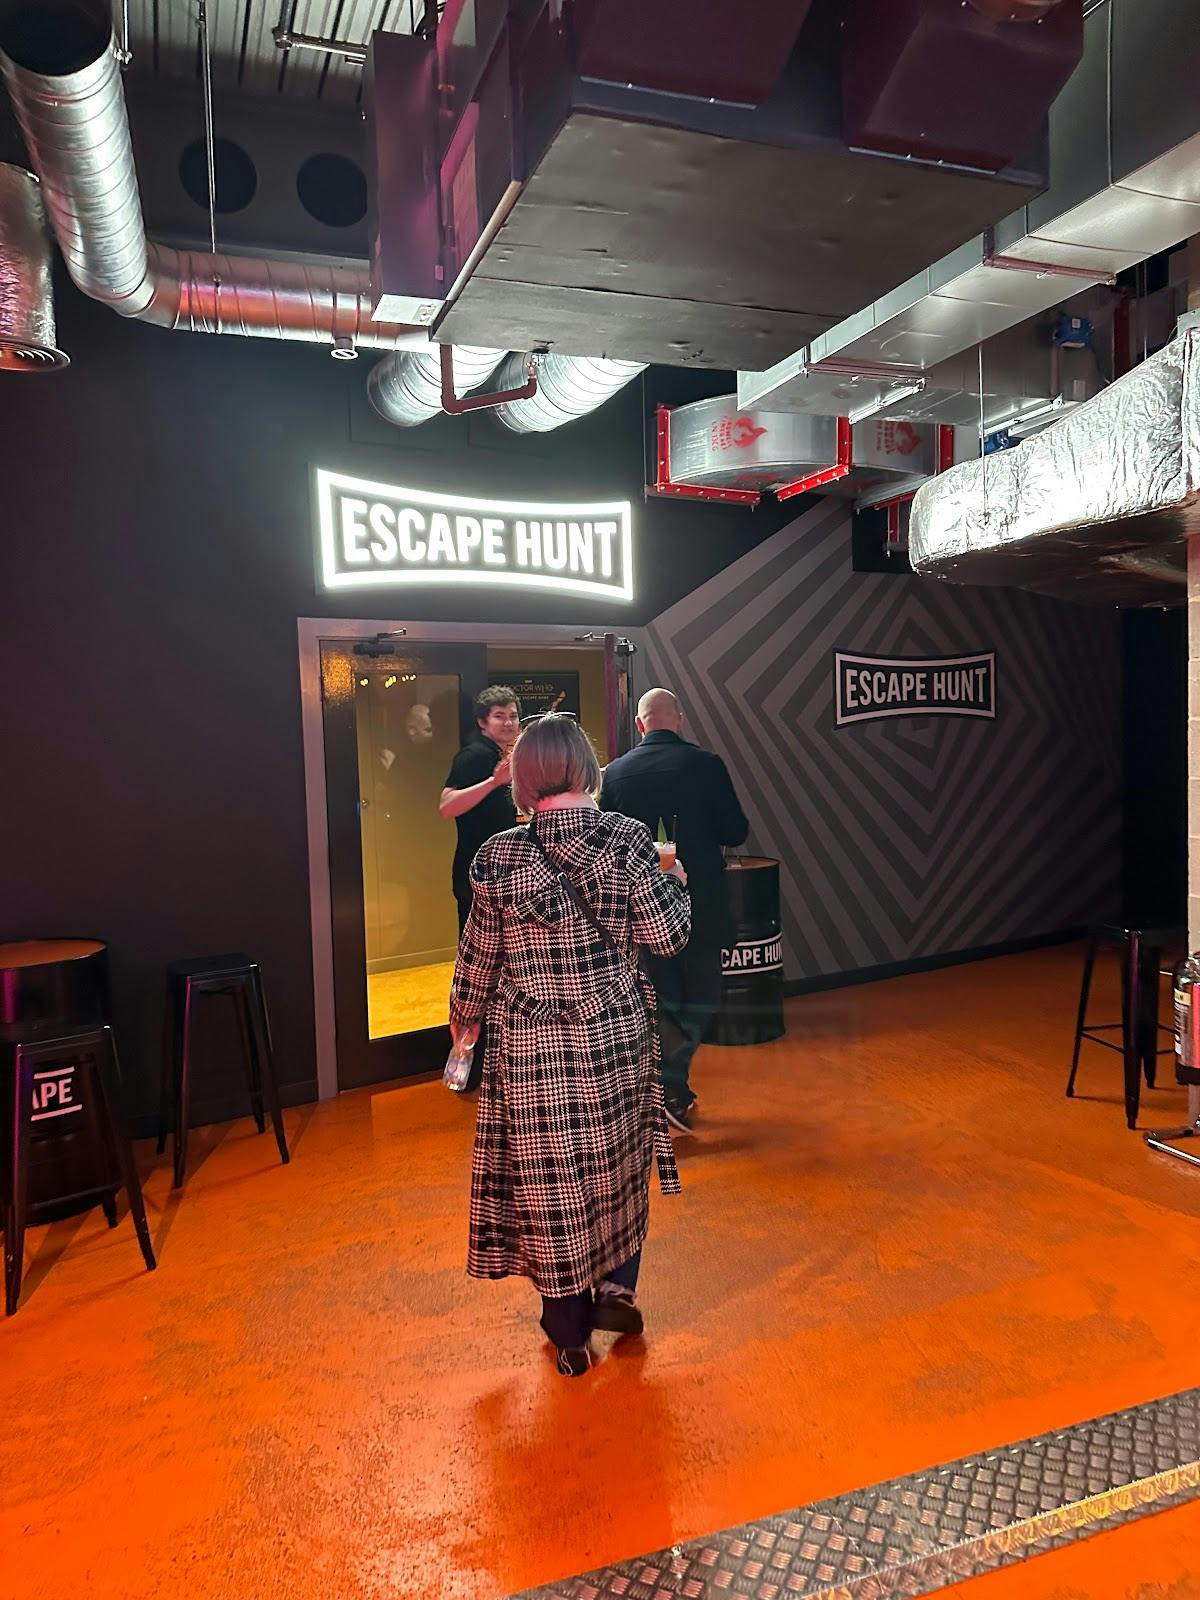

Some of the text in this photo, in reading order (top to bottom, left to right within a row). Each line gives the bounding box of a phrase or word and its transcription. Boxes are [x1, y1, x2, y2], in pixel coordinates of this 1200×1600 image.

[340, 496, 616, 577] ESCAPE HUNT
[845, 667, 987, 708] ESCAPE HUNT
[720, 942, 782, 967] CAPE HUN
